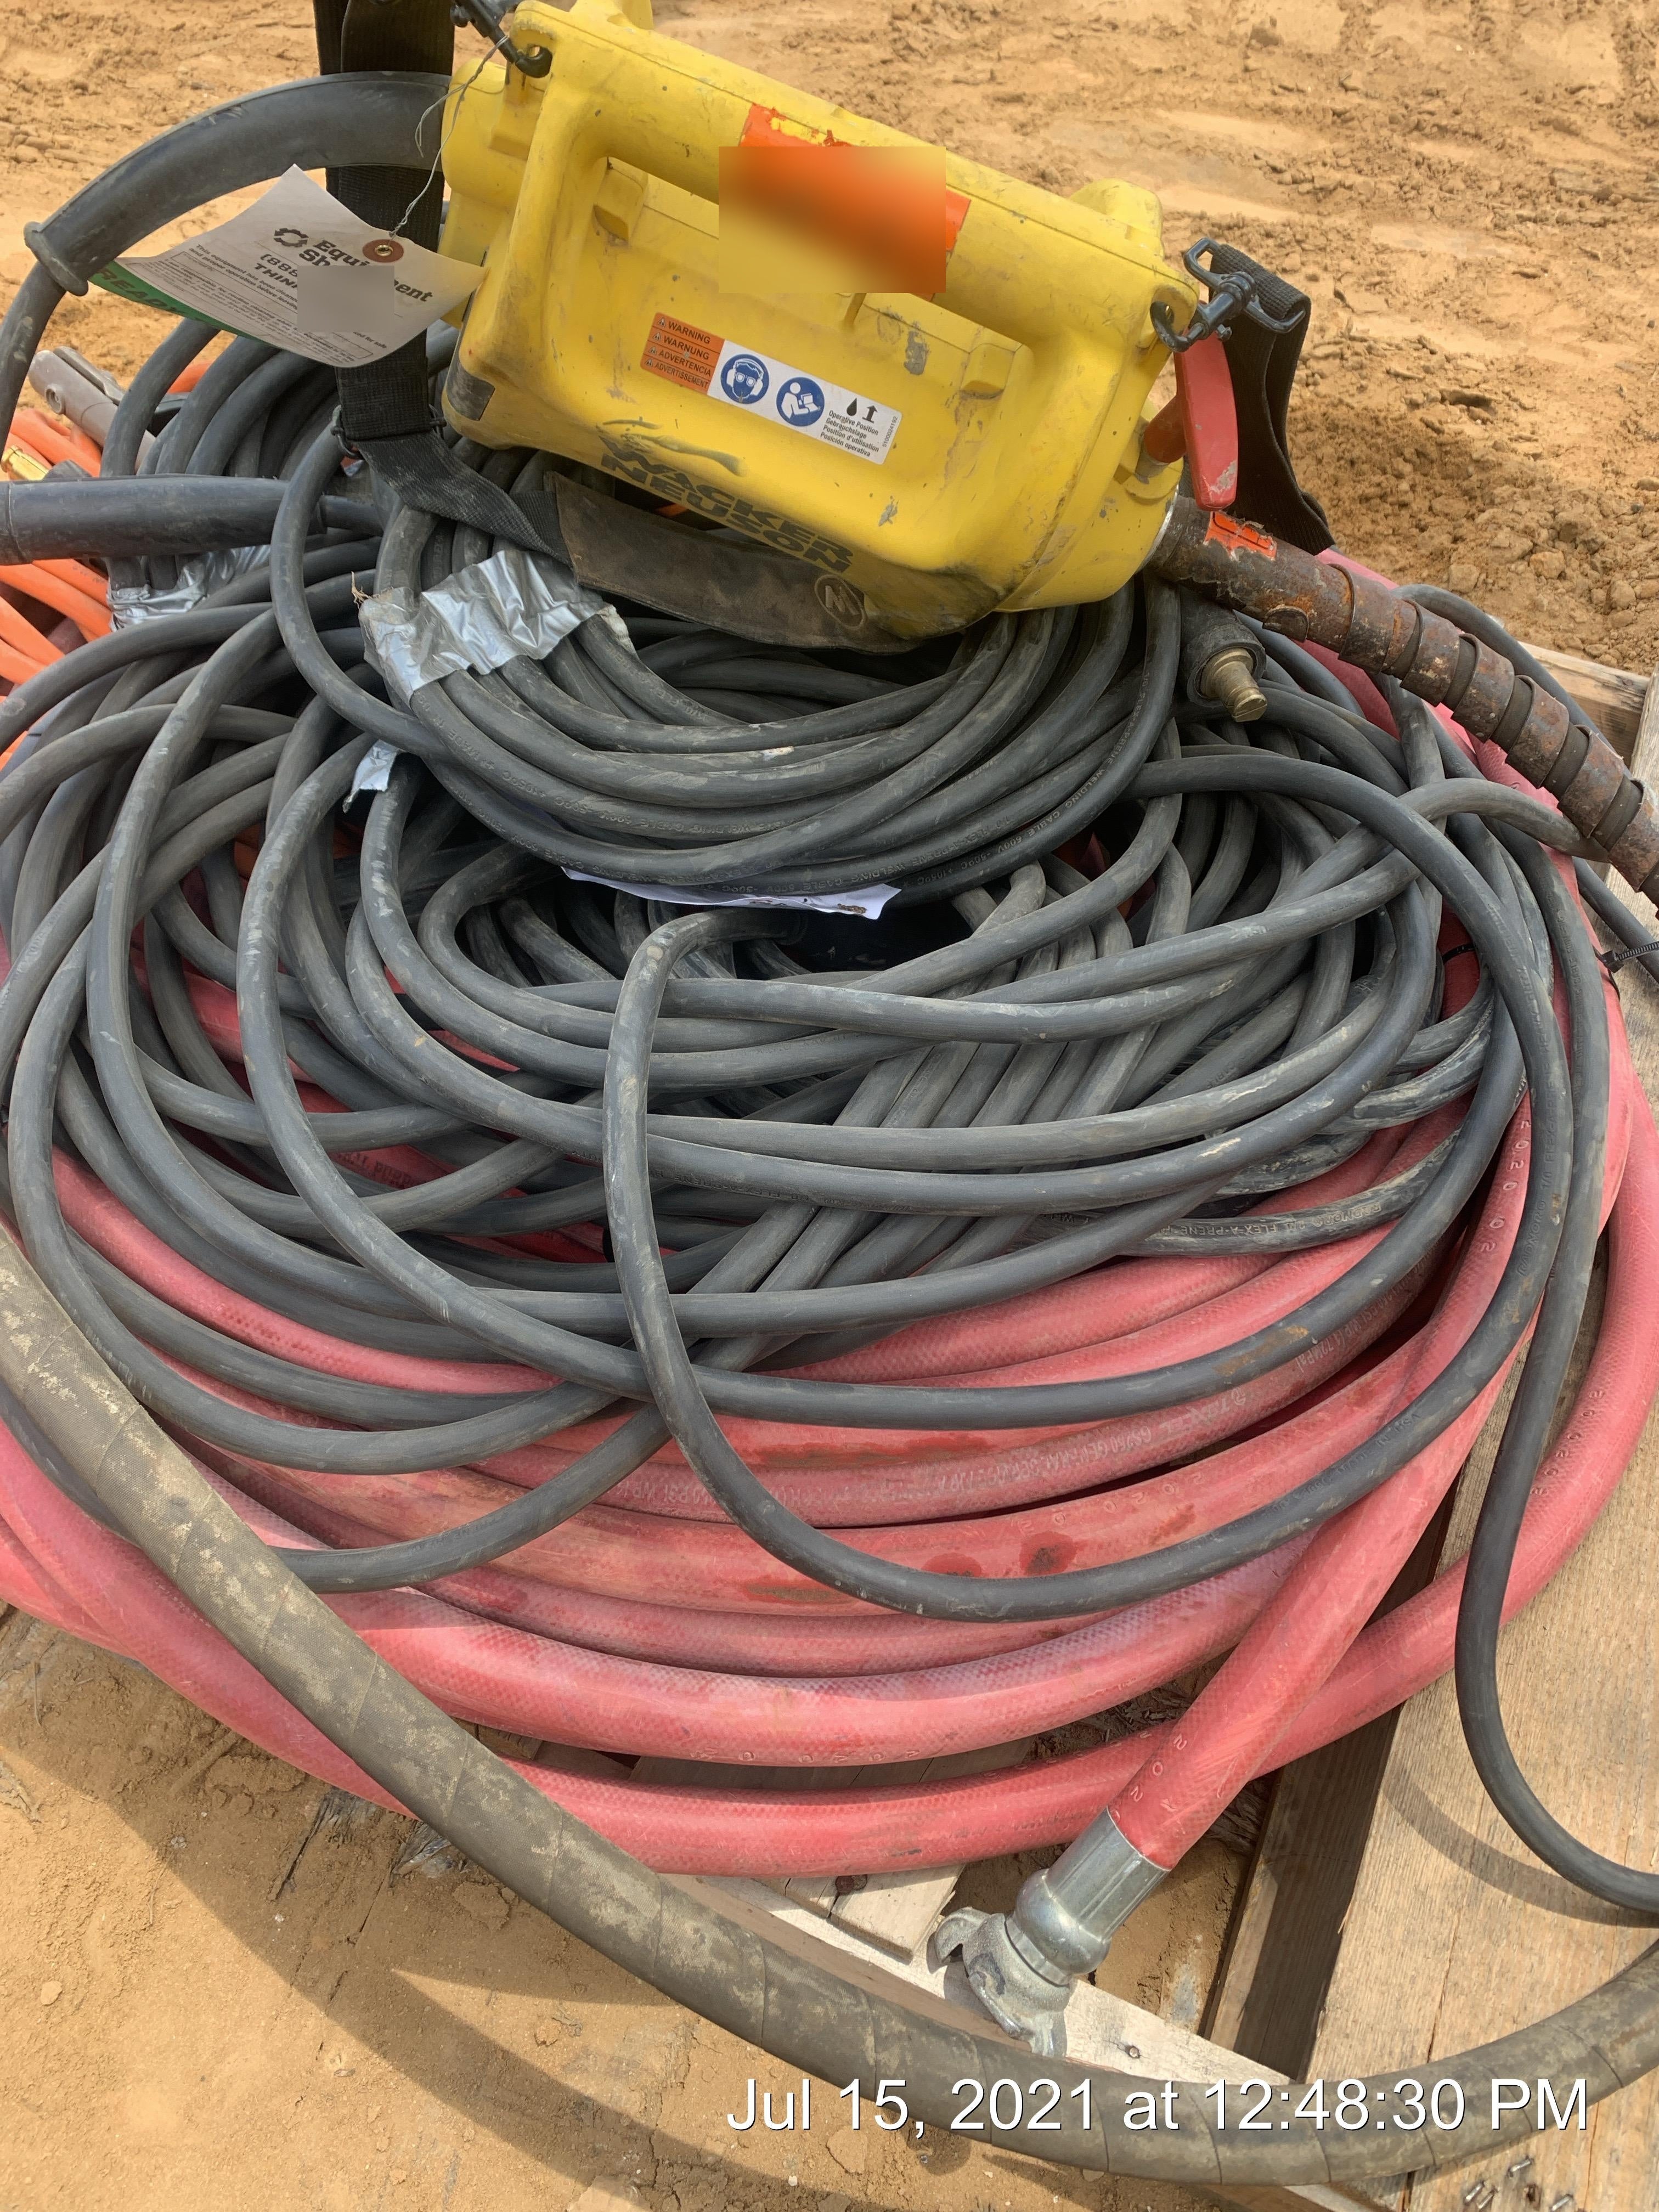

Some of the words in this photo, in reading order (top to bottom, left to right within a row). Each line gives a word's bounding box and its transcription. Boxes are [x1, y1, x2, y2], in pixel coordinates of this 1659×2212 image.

[188, 247, 204, 258] and
[202, 255, 226, 270] proper
[225, 267, 256, 286] operation
[256, 284, 277, 297] before
[195, 243, 210, 256] This
[210, 252, 247, 275] equipment
[246, 272, 259, 282] has
[259, 279, 276, 290] been
[668, 320, 711, 345] WARNING
[663, 335, 710, 360] WARNUNG
[653, 363, 709, 389] ADVERTISSEMENT
[658, 349, 712, 377] ADVERTENCIA
[826, 417, 867, 439] Gebrauchslage
[828, 410, 855, 426] Operative
[856, 421, 879, 436] Position
[882, 416, 898, 448] 5100024192
[820, 431, 844, 446] Posición
[844, 442, 871, 457] operativa
[823, 425, 846, 439] Position
[846, 433, 880, 453] d'utilisation
[599, 435, 854, 564] WACKER
[601, 453, 853, 573] NEUSON
[1064, 769, 1105, 809] WELDING
[1026, 810, 1061, 836] CABLE
[996, 835, 1022, 854] 600V
[544, 849, 585, 870] CABLE
[850, 862, 905, 883] WELDING
[801, 877, 843, 890] CABLE
